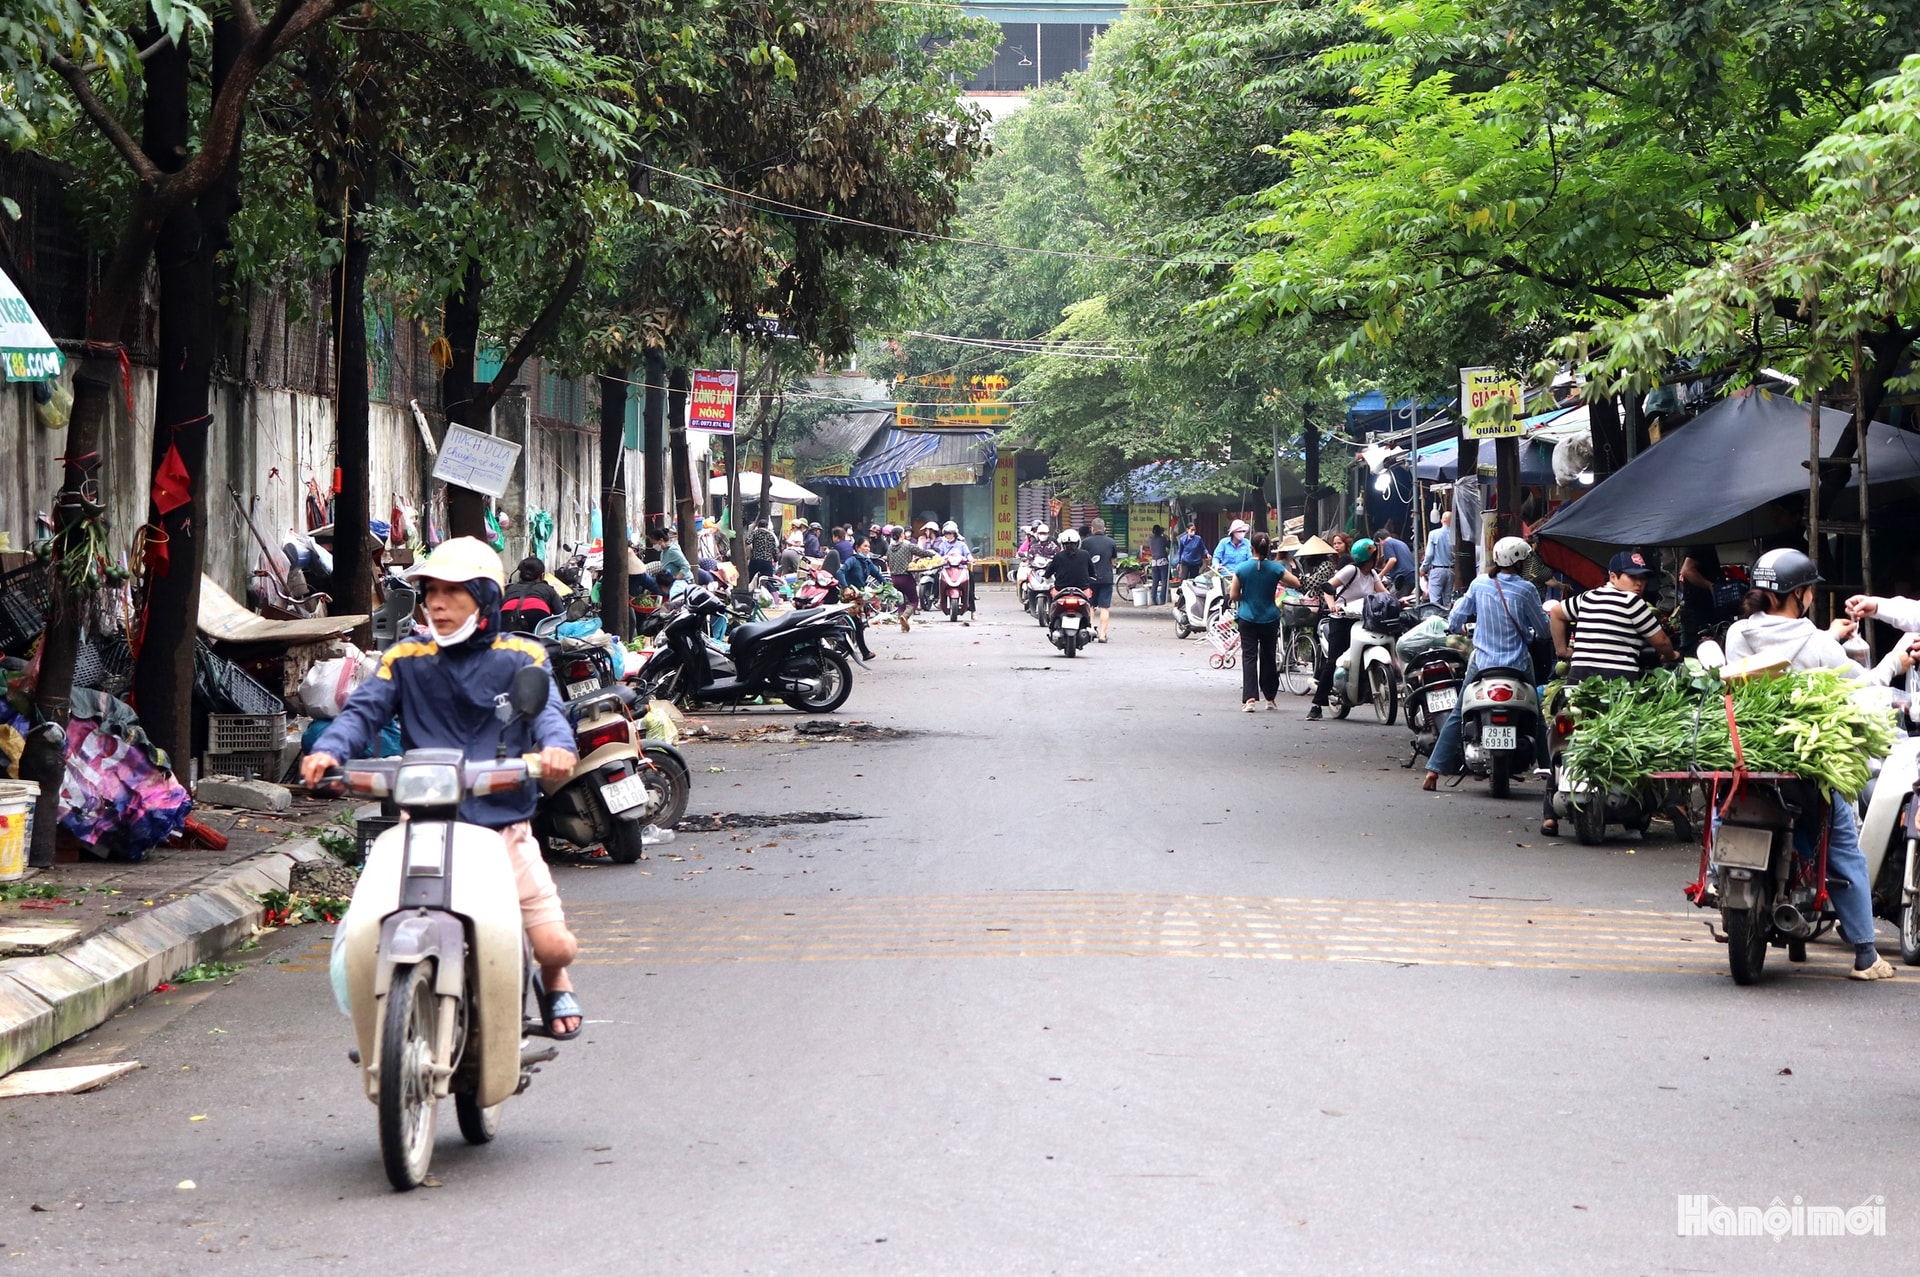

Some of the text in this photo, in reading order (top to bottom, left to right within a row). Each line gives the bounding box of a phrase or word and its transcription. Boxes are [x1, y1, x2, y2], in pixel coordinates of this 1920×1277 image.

[693, 384, 716, 404] LÒNG
[698, 406, 725, 419] NÓNG
[1488, 728, 1511, 738] 29-AE
[1485, 738, 1514, 748] 693.81
[606, 780, 638, 798] 29-T1
[609, 790, 647, 811] 041.08
